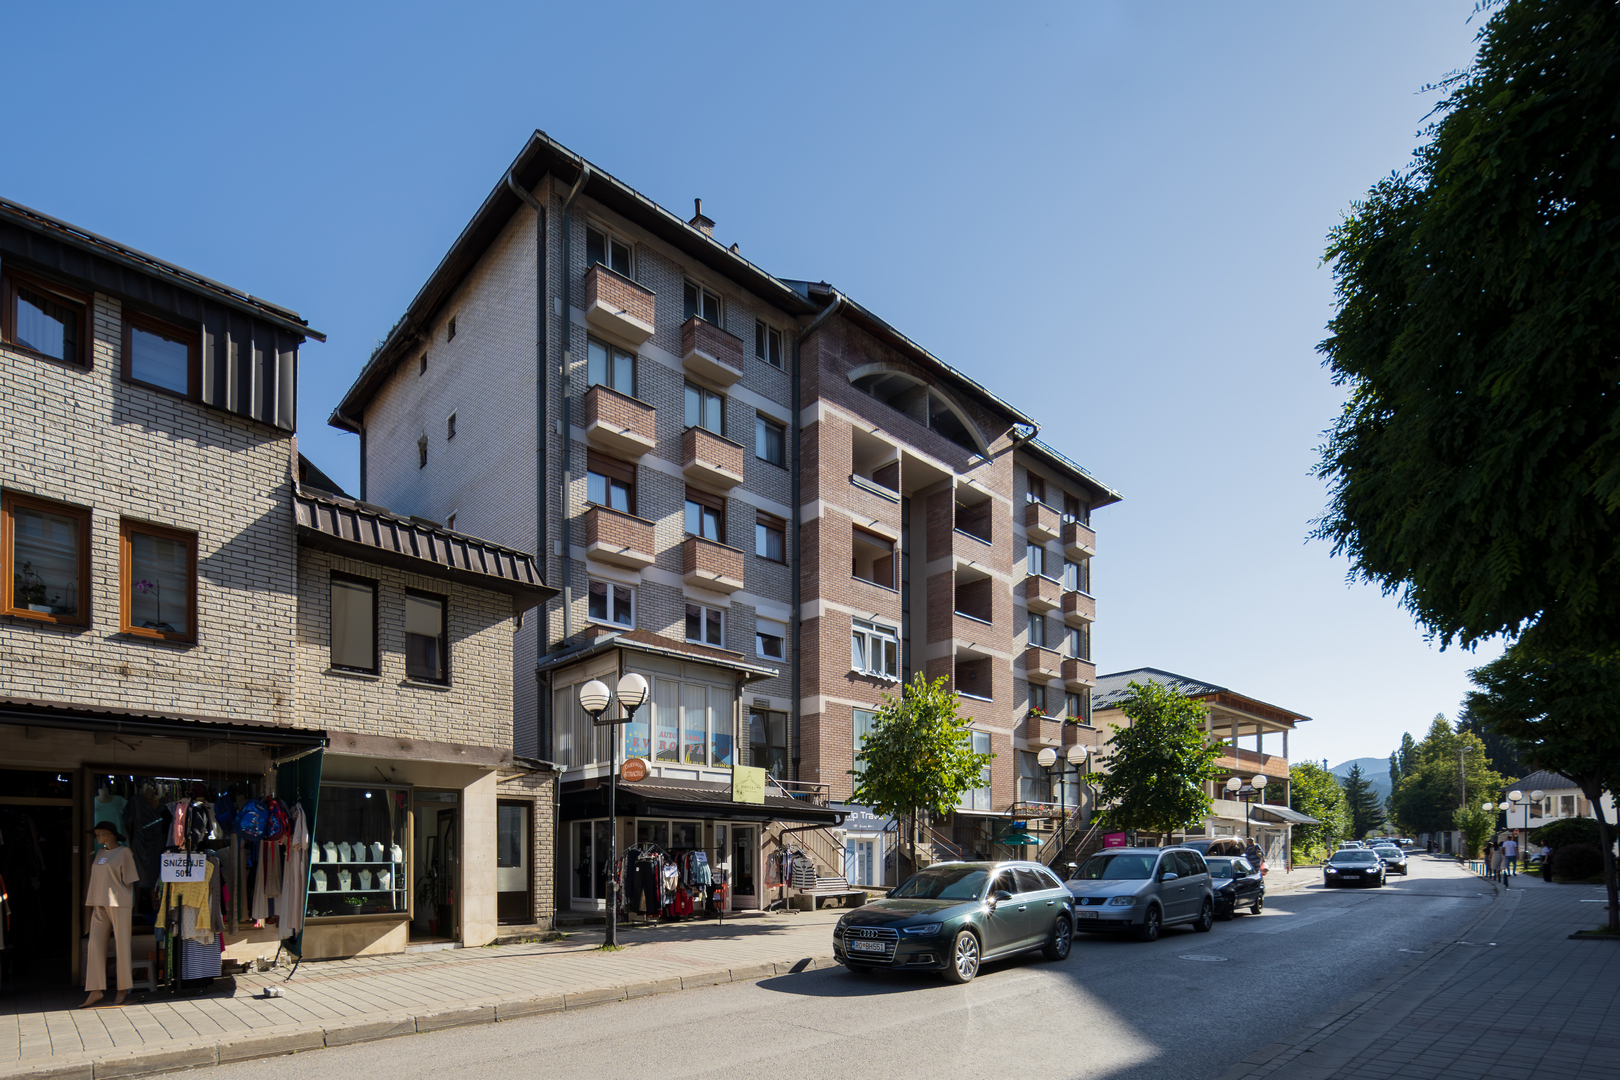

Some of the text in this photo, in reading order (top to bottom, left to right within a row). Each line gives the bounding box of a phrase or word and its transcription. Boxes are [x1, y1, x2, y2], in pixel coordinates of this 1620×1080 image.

[659, 731, 706, 743] AUTO ŠKOLA
[860, 811, 885, 820] Trav
